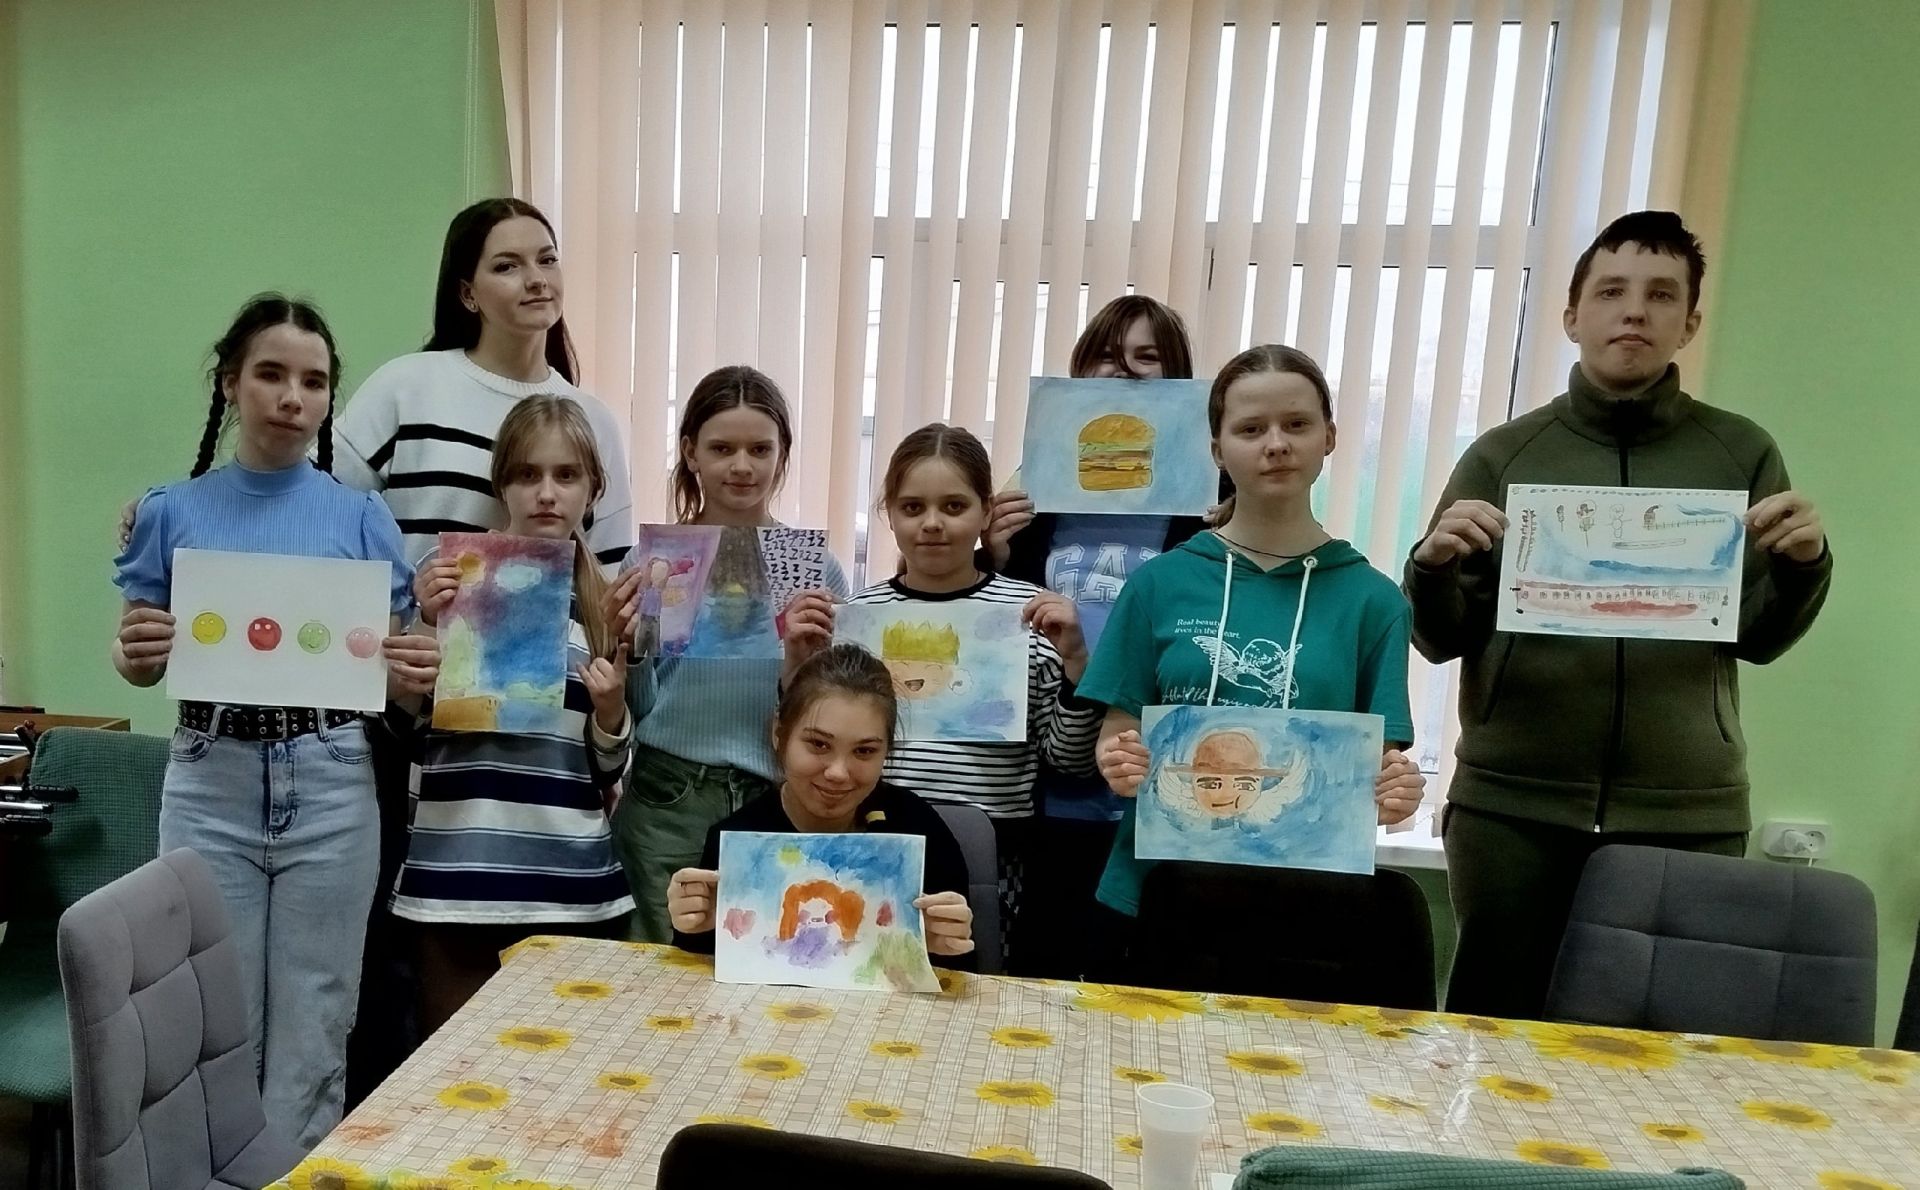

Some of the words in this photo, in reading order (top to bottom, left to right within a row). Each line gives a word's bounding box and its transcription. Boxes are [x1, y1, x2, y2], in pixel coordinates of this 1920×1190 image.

[1045, 543, 1161, 604] GA
[1177, 618, 1195, 626] Real
[1204, 627, 1217, 635] the
[1223, 631, 1241, 640] eart.
